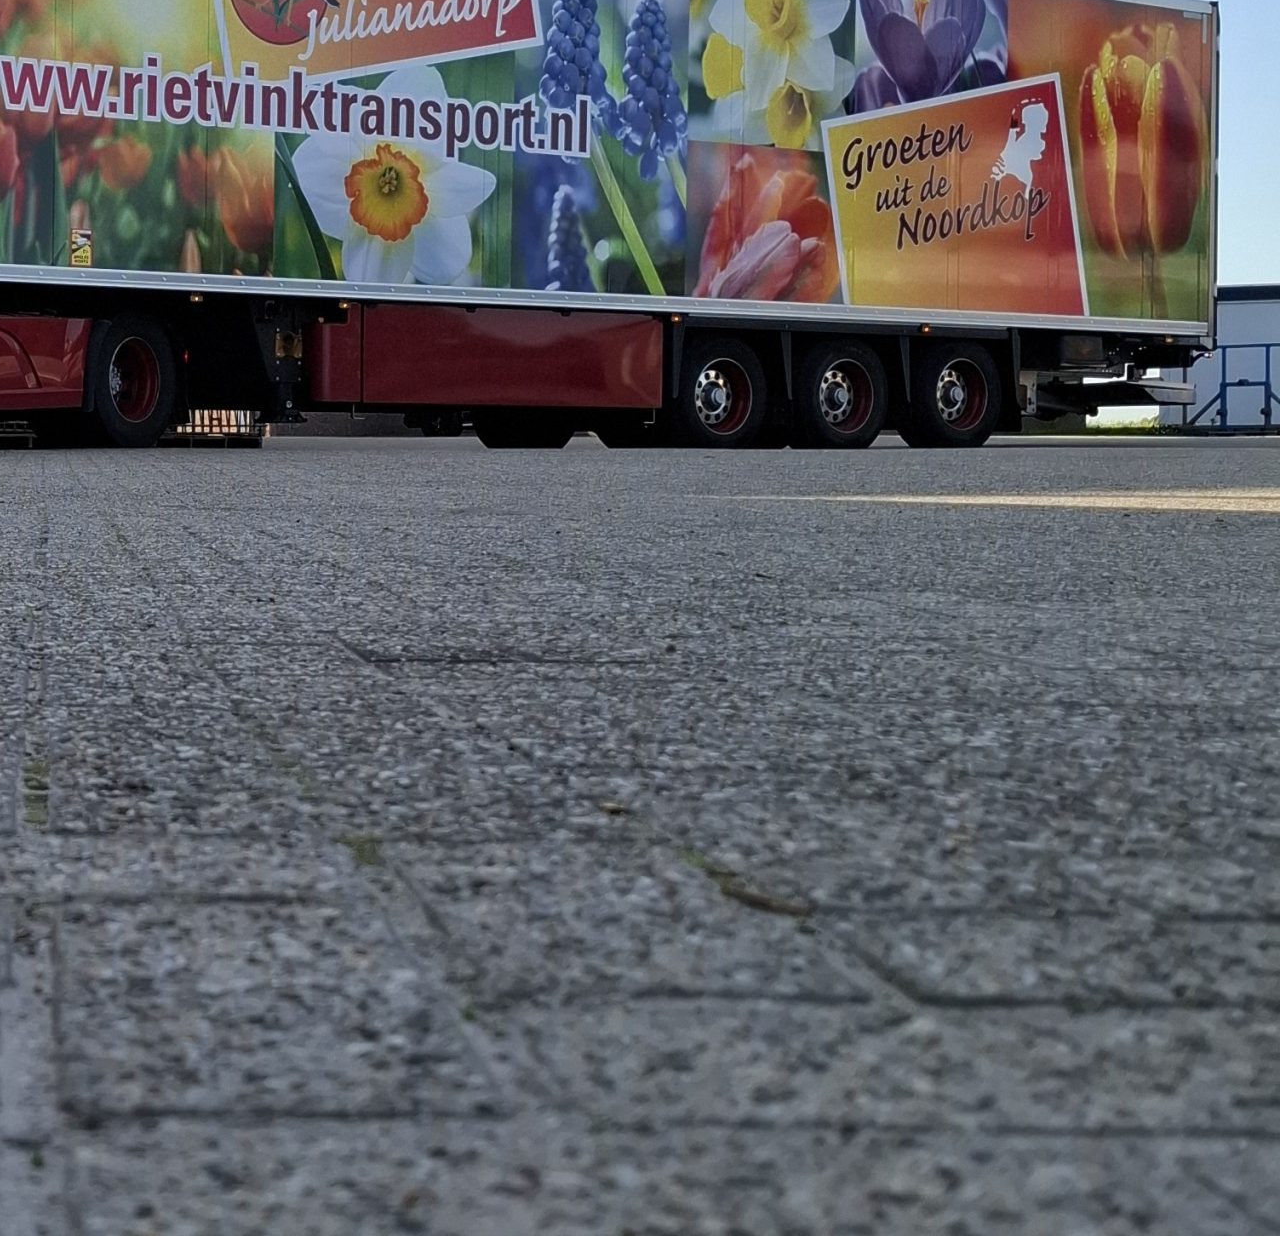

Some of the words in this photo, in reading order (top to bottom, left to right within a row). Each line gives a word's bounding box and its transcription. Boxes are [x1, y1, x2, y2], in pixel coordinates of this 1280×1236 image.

[842, 123, 973, 190] Groeten
[875, 174, 915, 213] uit
[920, 164, 952, 203] de
[896, 179, 1050, 251] Noordkop
